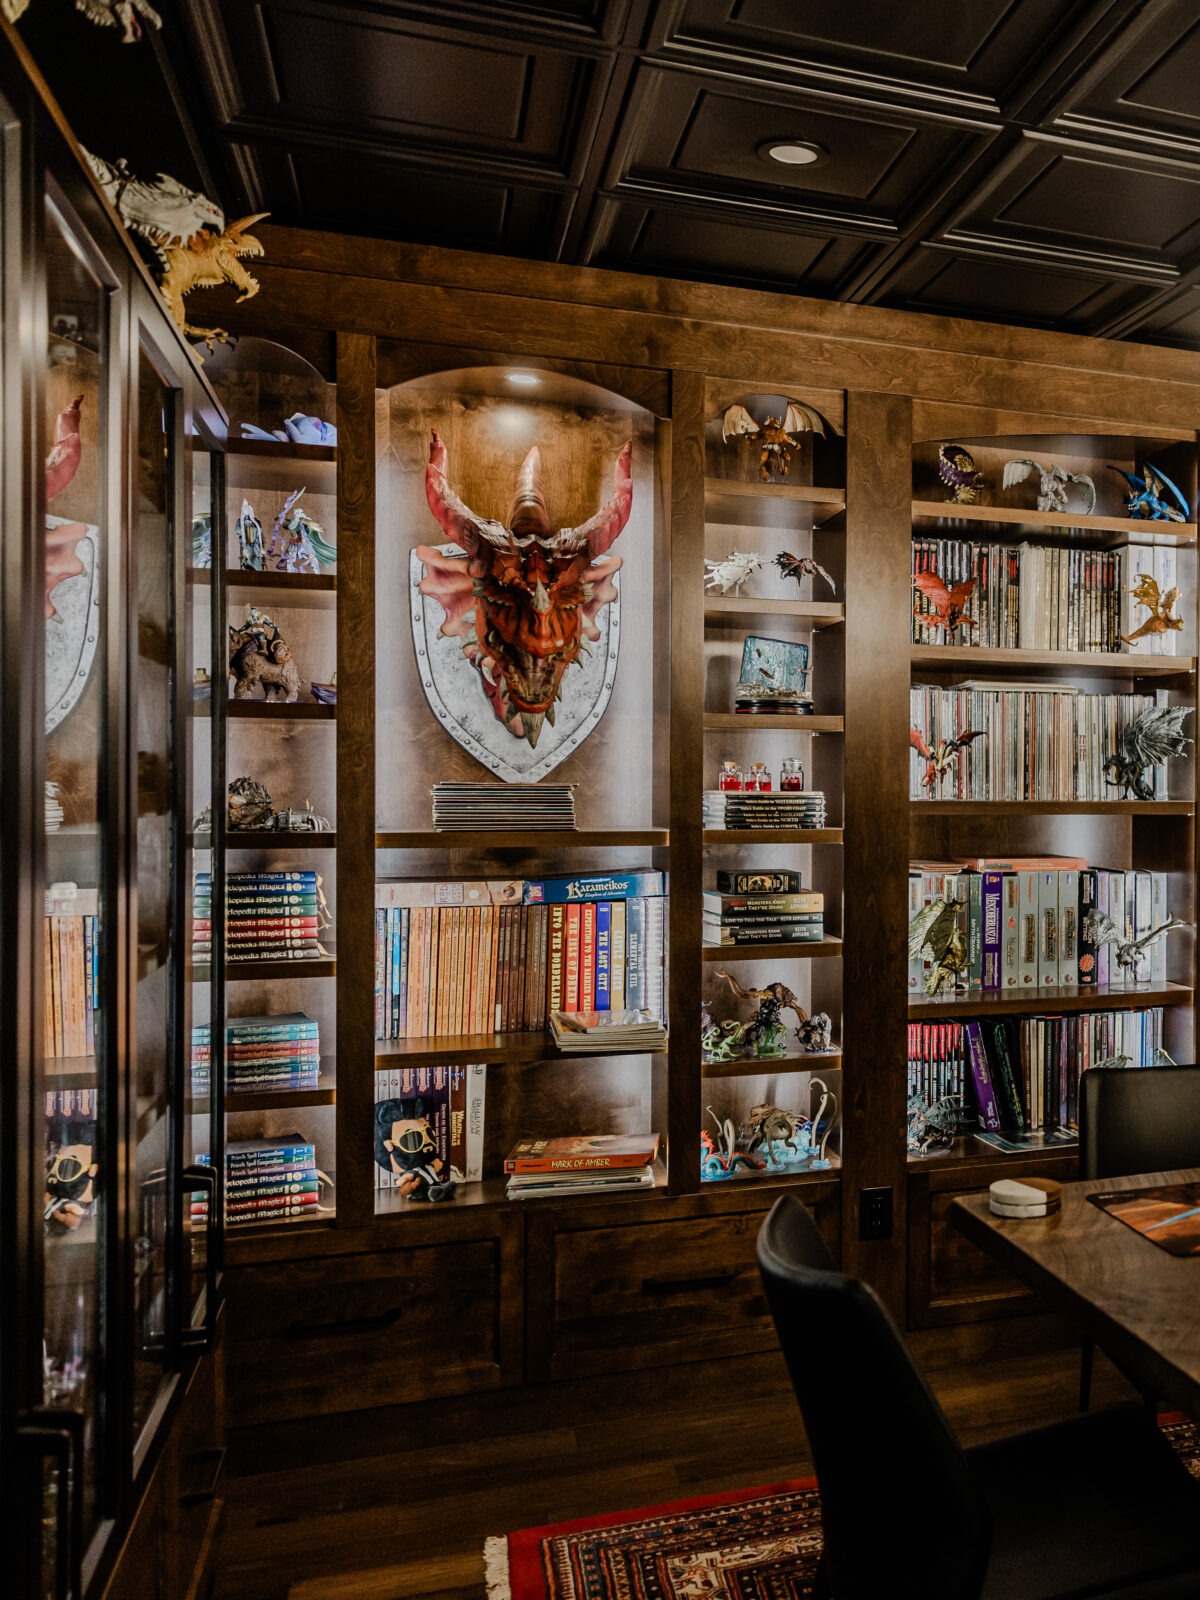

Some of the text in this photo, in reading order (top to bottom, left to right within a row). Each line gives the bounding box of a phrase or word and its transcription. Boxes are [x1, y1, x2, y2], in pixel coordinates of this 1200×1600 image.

[565, 880, 629, 899] Karameikos
[553, 907, 562, 928] INTO
[552, 932, 562, 950] THE
[567, 918, 578, 1004] THE ISLE OF DREAD
[598, 931, 608, 991] THE LOST CITY
[613, 930, 624, 990] CASTLE AMBER
[551, 1158, 610, 1168] MARK OF AMBER
[226, 1190, 255, 1199] clopedia
[226, 1214, 255, 1222] clopedia
